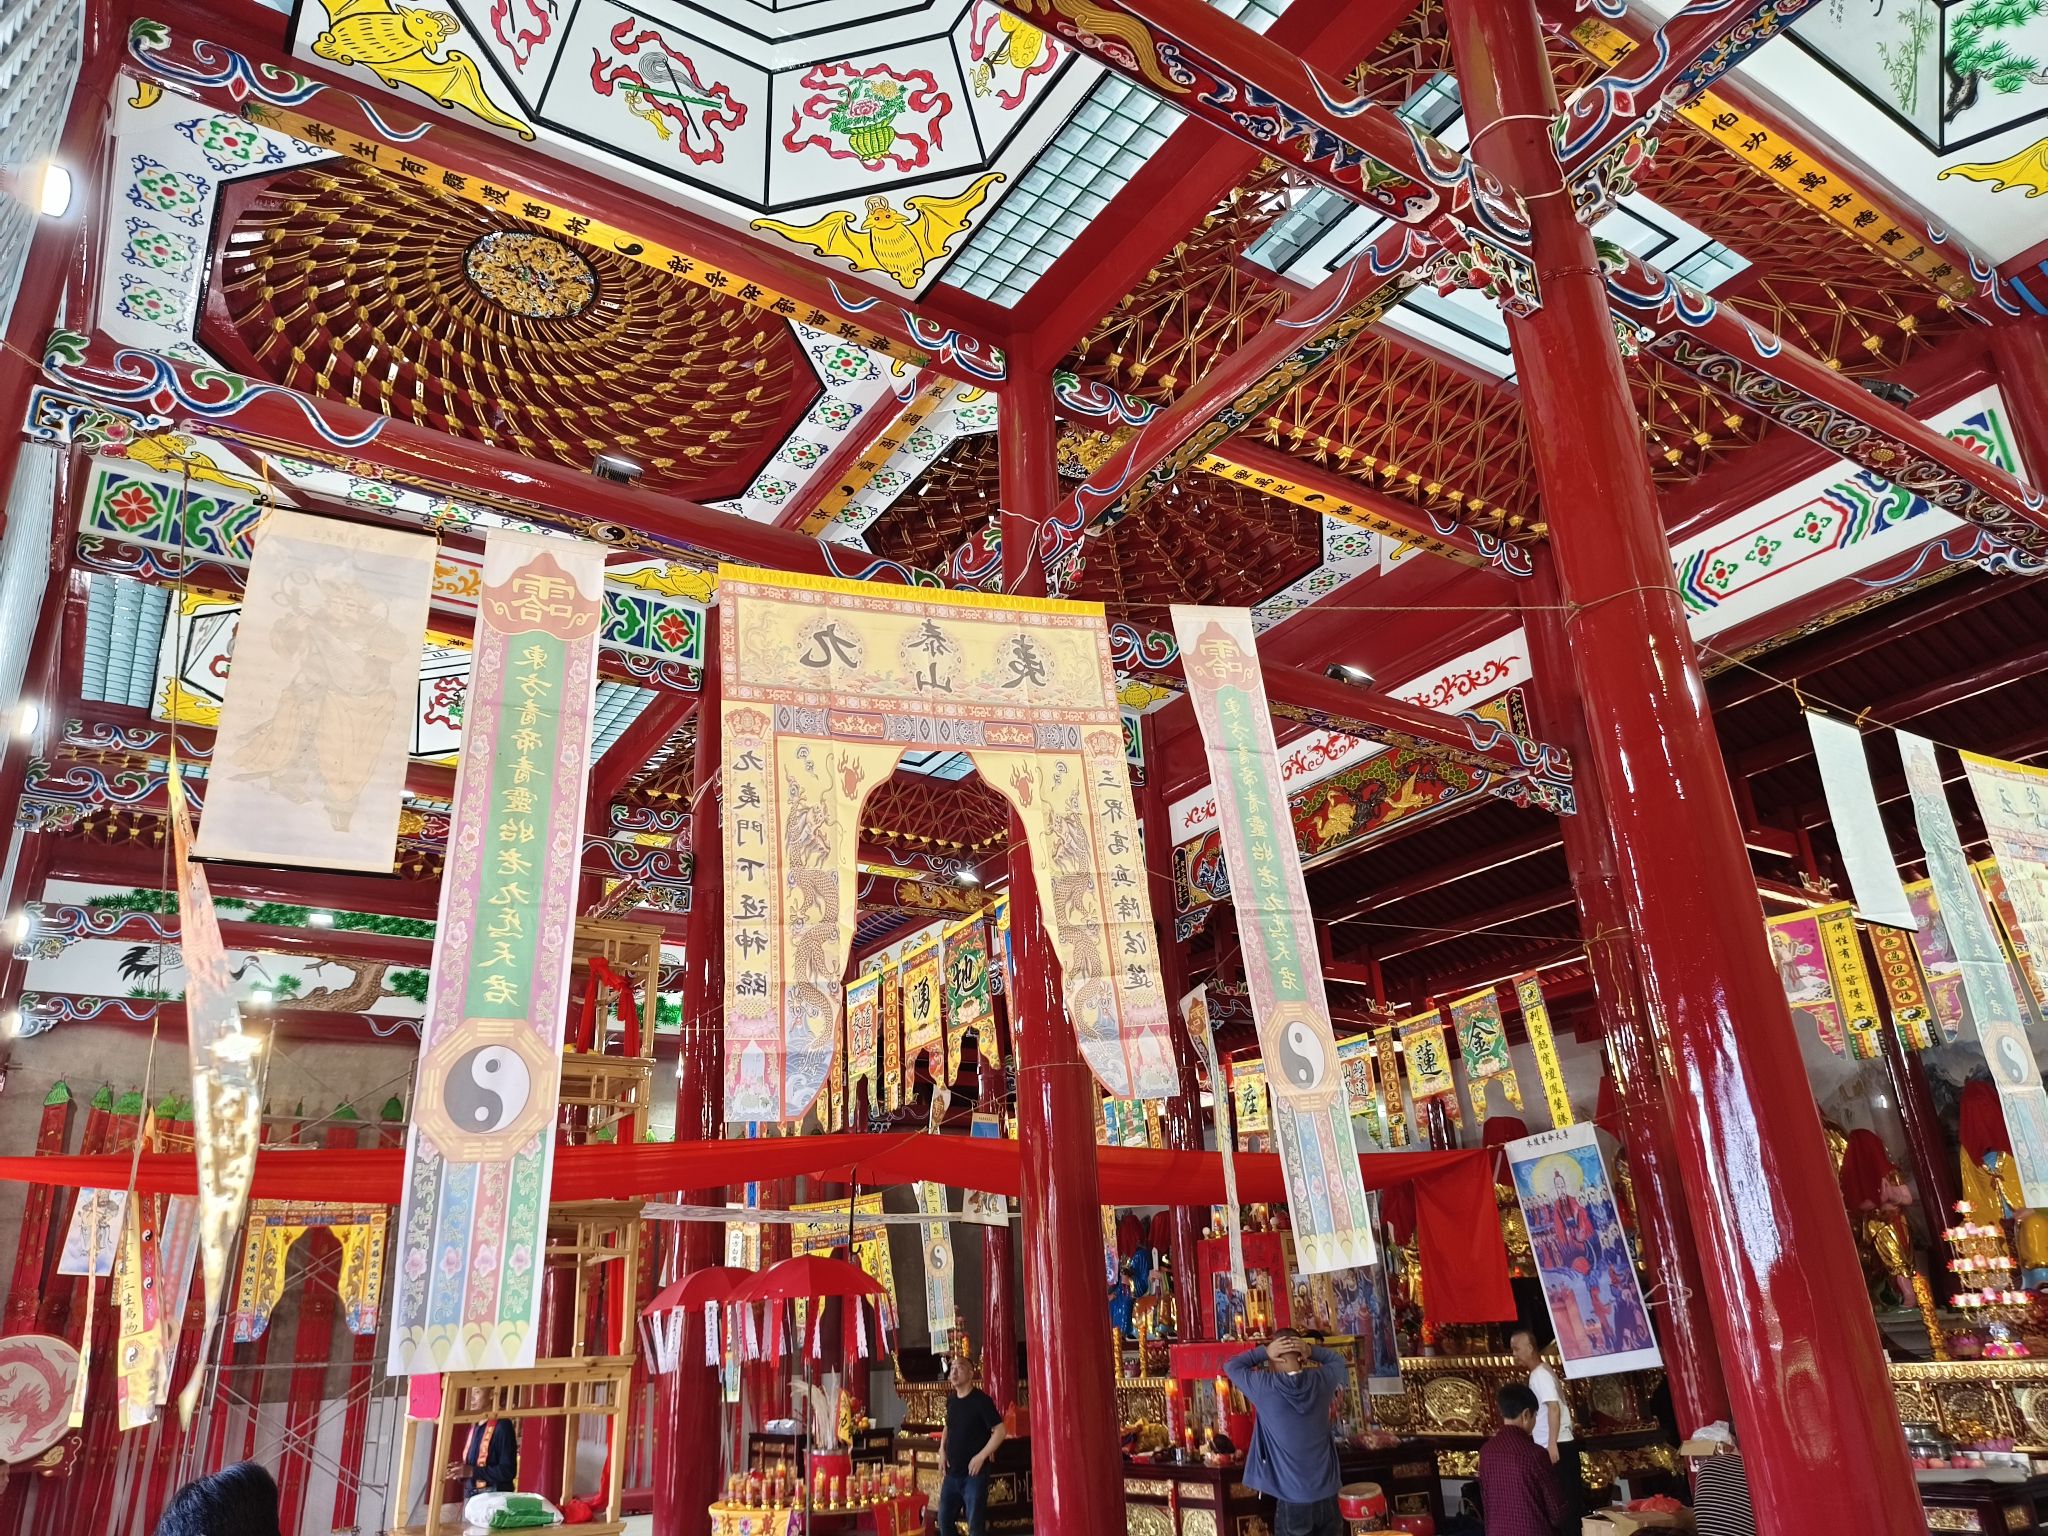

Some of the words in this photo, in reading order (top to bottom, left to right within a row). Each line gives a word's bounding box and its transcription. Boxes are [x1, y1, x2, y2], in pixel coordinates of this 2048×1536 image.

[857, 385, 945, 473] 風調雨順
[953, 954, 980, 997] 地
[1467, 1021, 1496, 1056] 金
[1416, 1040, 1442, 1076] 蓮
[1242, 1084, 1258, 1117] 座
